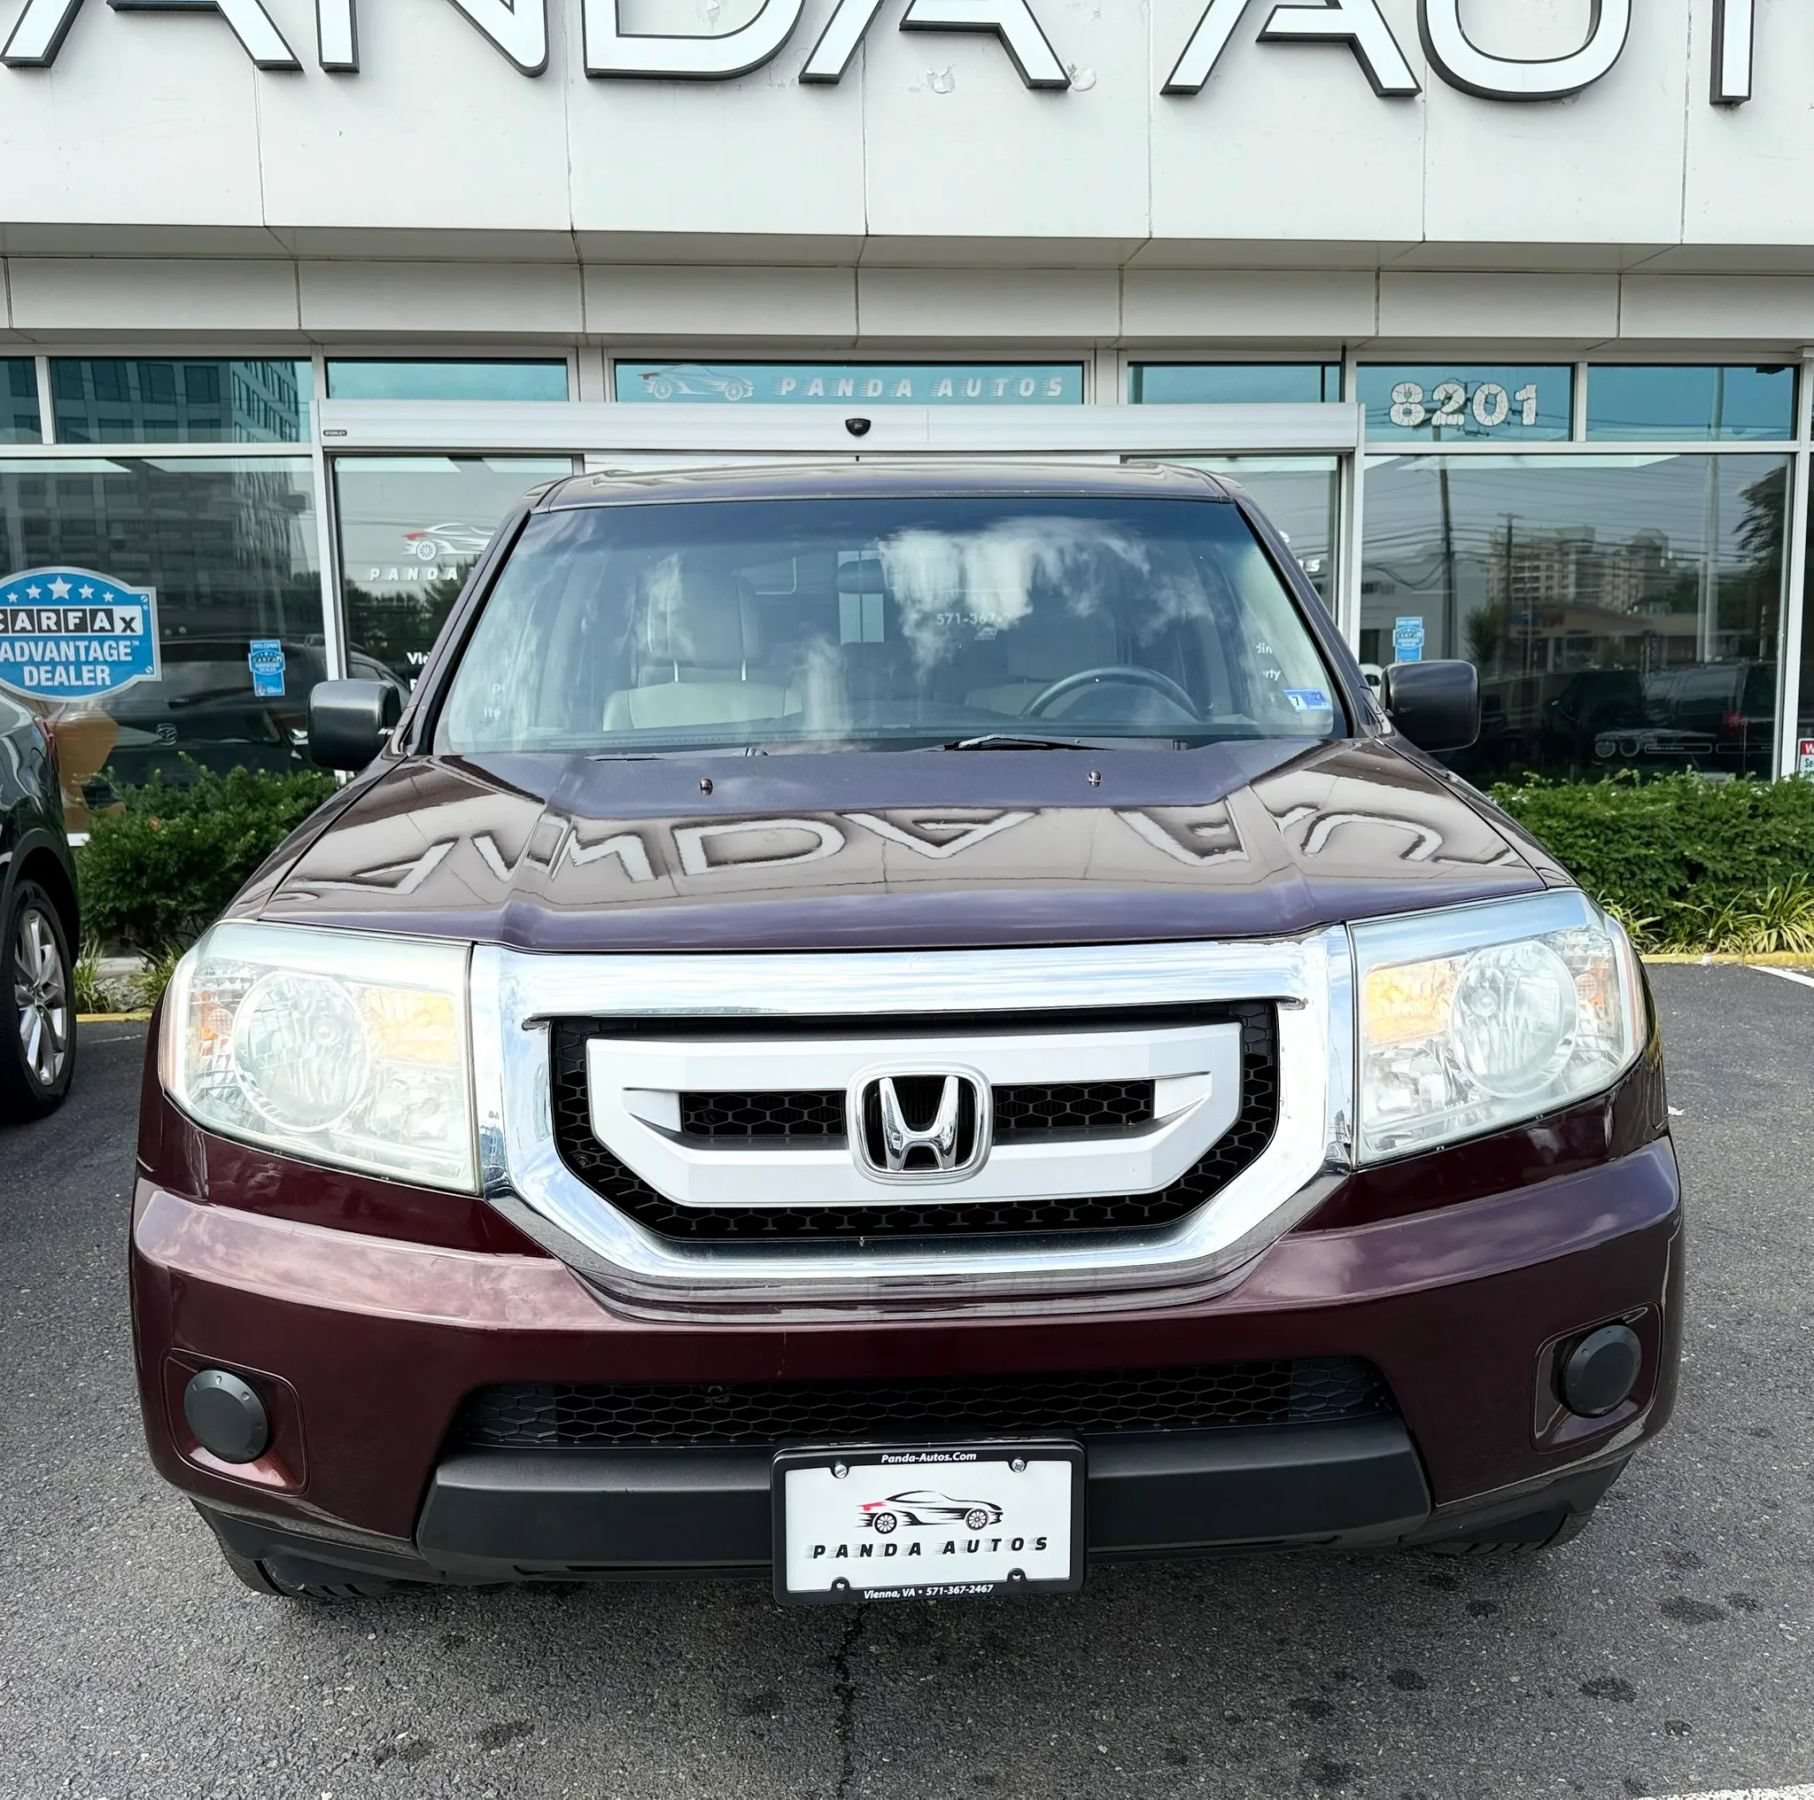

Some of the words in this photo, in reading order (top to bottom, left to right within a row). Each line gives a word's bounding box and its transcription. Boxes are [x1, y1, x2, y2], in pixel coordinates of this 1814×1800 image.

[777, 377, 913, 398] PANDA
[934, 377, 1063, 398] AUTOS
[1389, 382, 1537, 427] 8201
[369, 567, 458, 581] PANDA
[23, 665, 112, 687] DEALER
[881, 1451, 977, 1464] Panda-Autos.Com
[812, 1542, 922, 1558] PANDA
[942, 1536, 1048, 1555] AUTOS
[863, 1589, 901, 1600] Vienna,
[902, 1587, 916, 1597] VA
[925, 1583, 994, 1596] 571-367-2467
